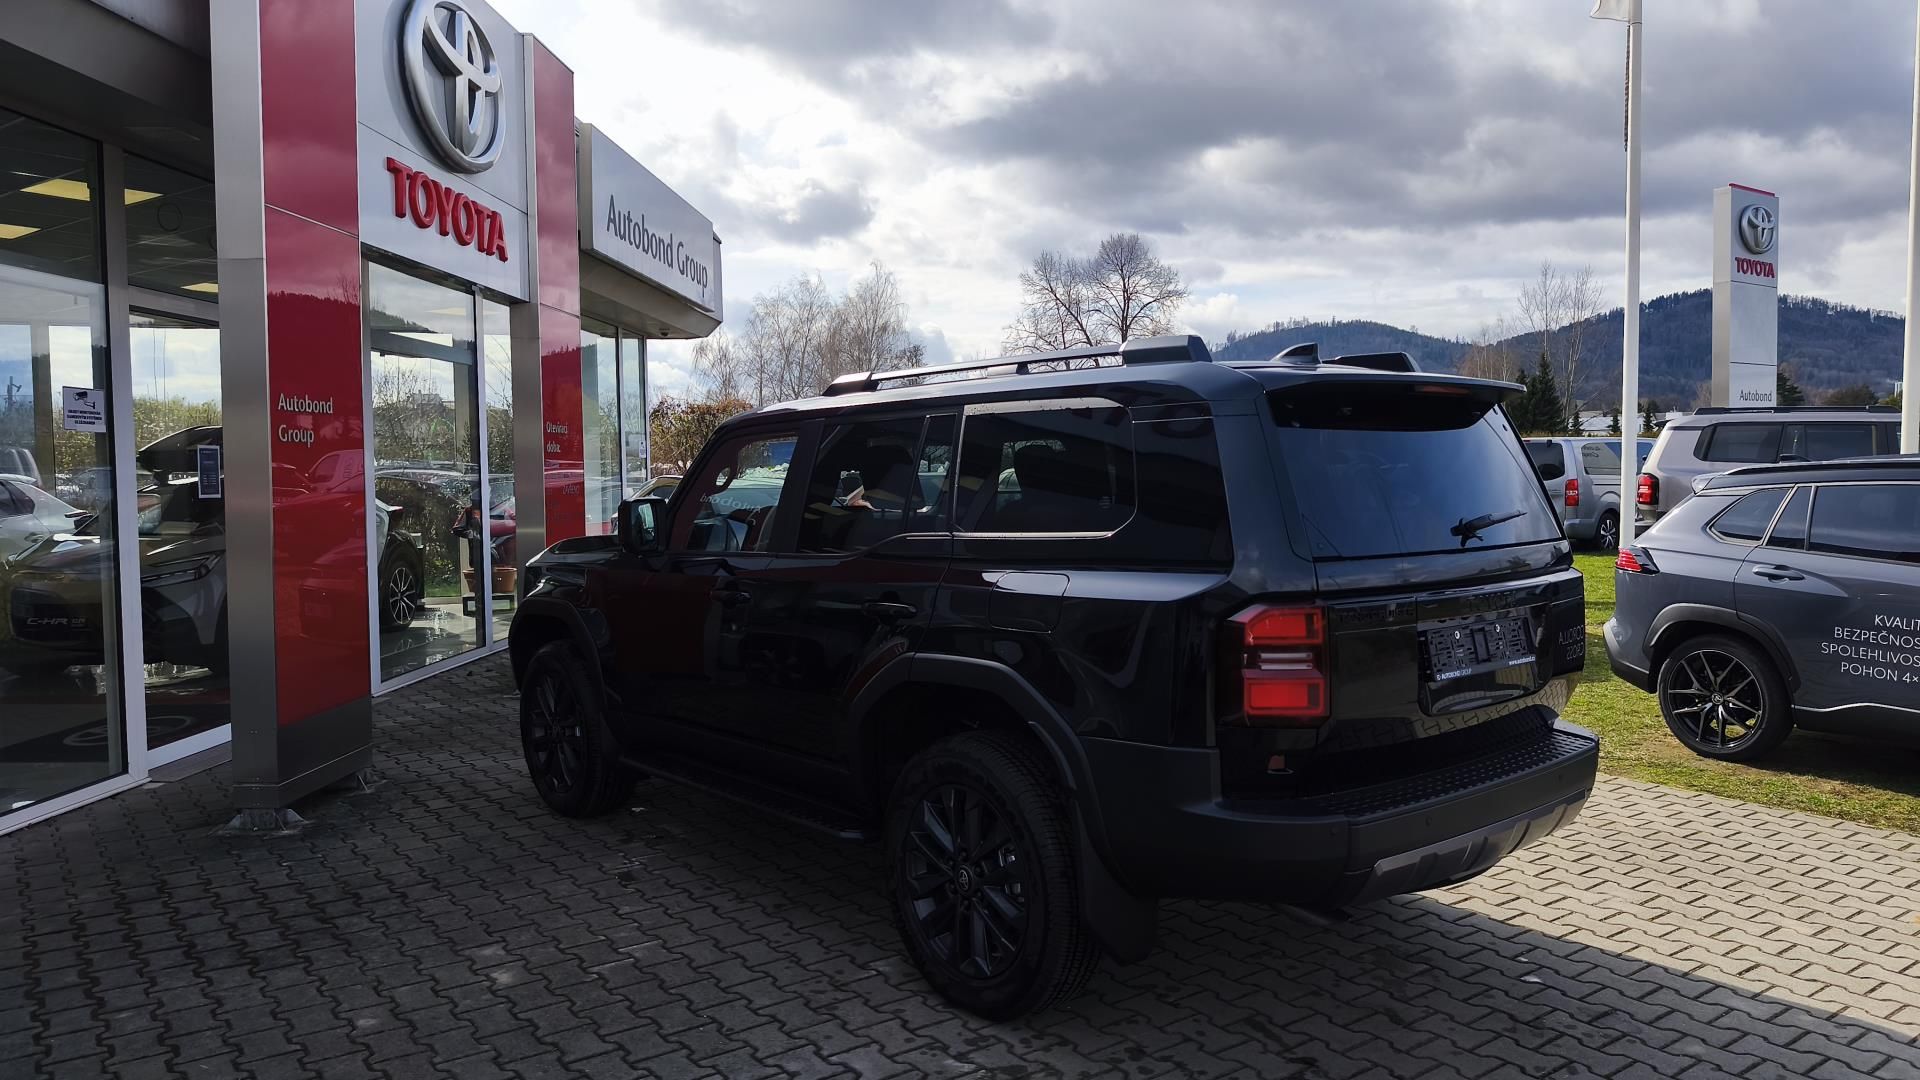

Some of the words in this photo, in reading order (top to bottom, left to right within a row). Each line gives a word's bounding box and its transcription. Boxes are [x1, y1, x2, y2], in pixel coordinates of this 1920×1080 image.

[386, 156, 509, 262] TOYOTA
[606, 194, 674, 269] Autobond
[676, 241, 708, 298] Group
[1735, 256, 1775, 278] TOYOTA
[278, 392, 333, 414] Autobond
[1739, 389, 1773, 402] Autobond
[278, 424, 315, 448] Group
[1841, 661, 1898, 681] POHON
